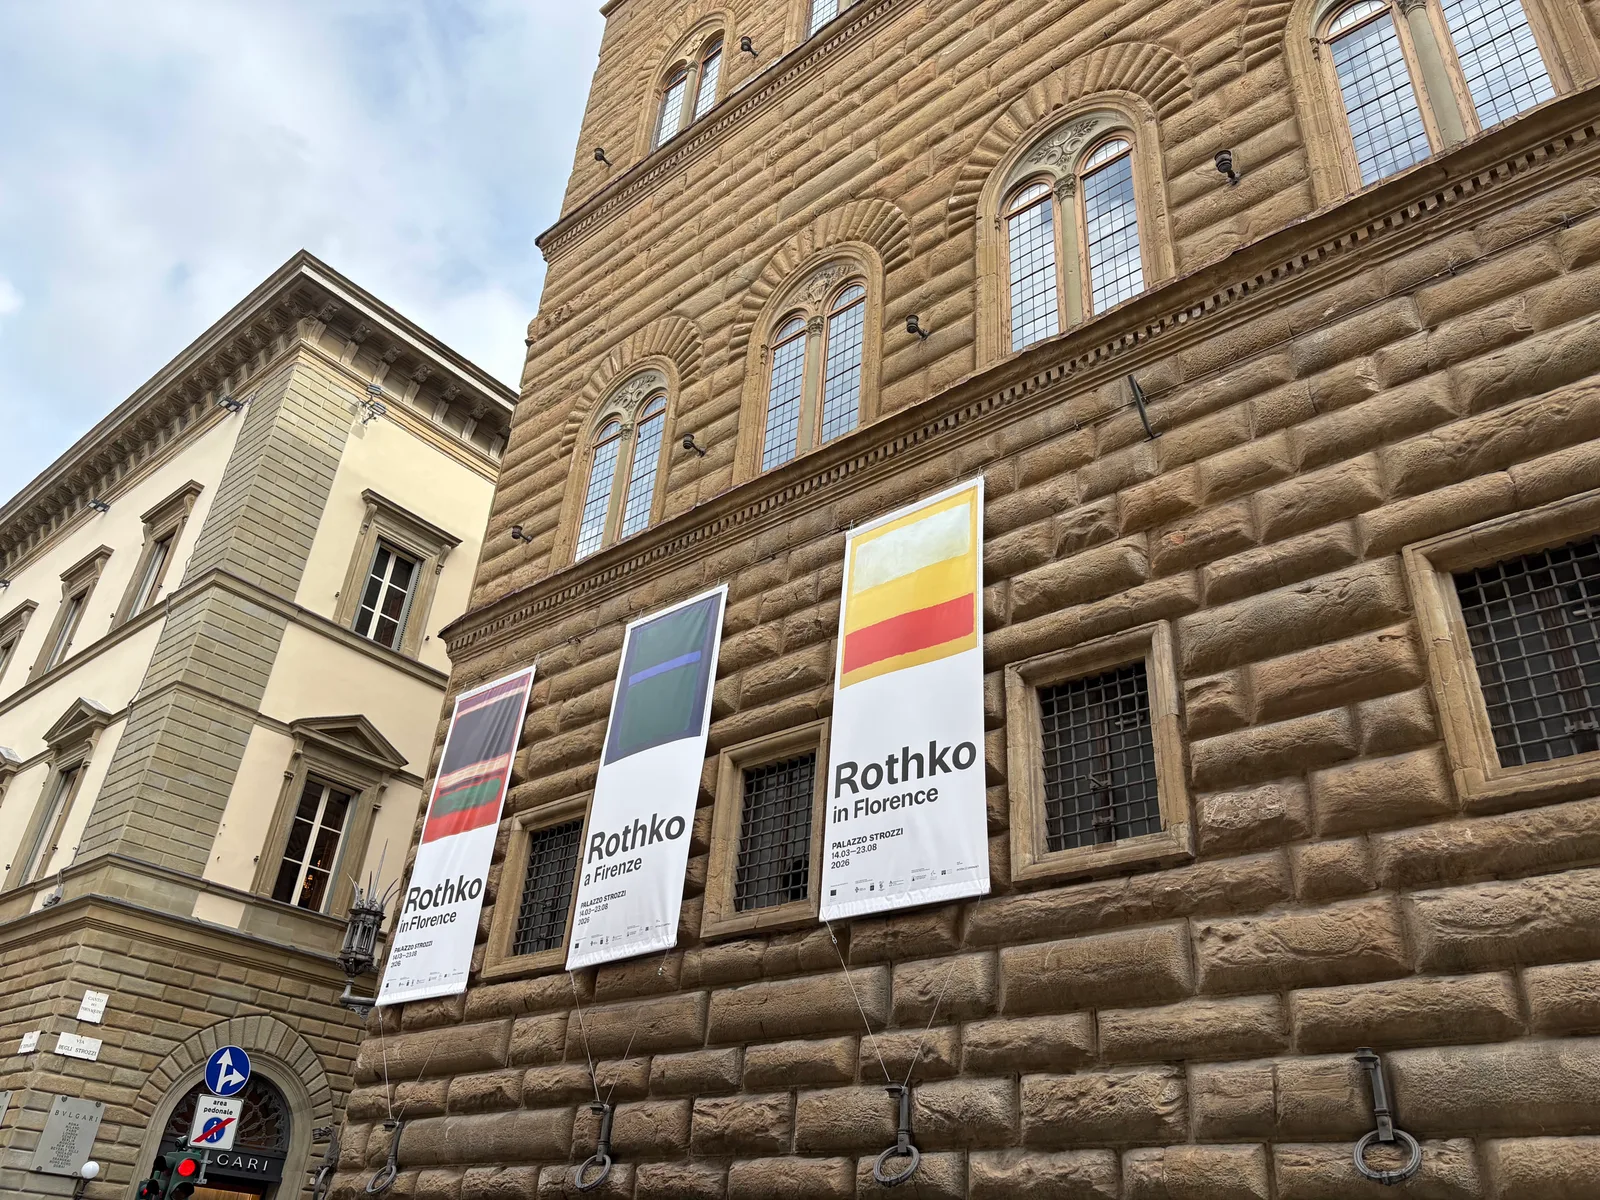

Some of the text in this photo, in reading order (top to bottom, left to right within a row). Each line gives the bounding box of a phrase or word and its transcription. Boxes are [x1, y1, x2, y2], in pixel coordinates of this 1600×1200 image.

[834, 740, 977, 799] Rothko
[832, 787, 939, 824] in Florence
[587, 813, 686, 865] Rothko
[831, 827, 904, 850] PALAZZO STROZZI
[583, 857, 642, 887] a Firenze
[830, 859, 850, 870] 2026
[404, 875, 483, 914] Rothko
[580, 889, 627, 909] PALAZZO STROZZI
[399, 911, 457, 933] in Florence
[577, 916, 590, 926] 2026
[58, 1044, 97, 1056] DEGLI STROZZI
[203, 1106, 233, 1116] pedonale
[213, 1099, 228, 1107] area
[54, 1110, 98, 1122] BVLGARI
[207, 1153, 268, 1171] GARI
